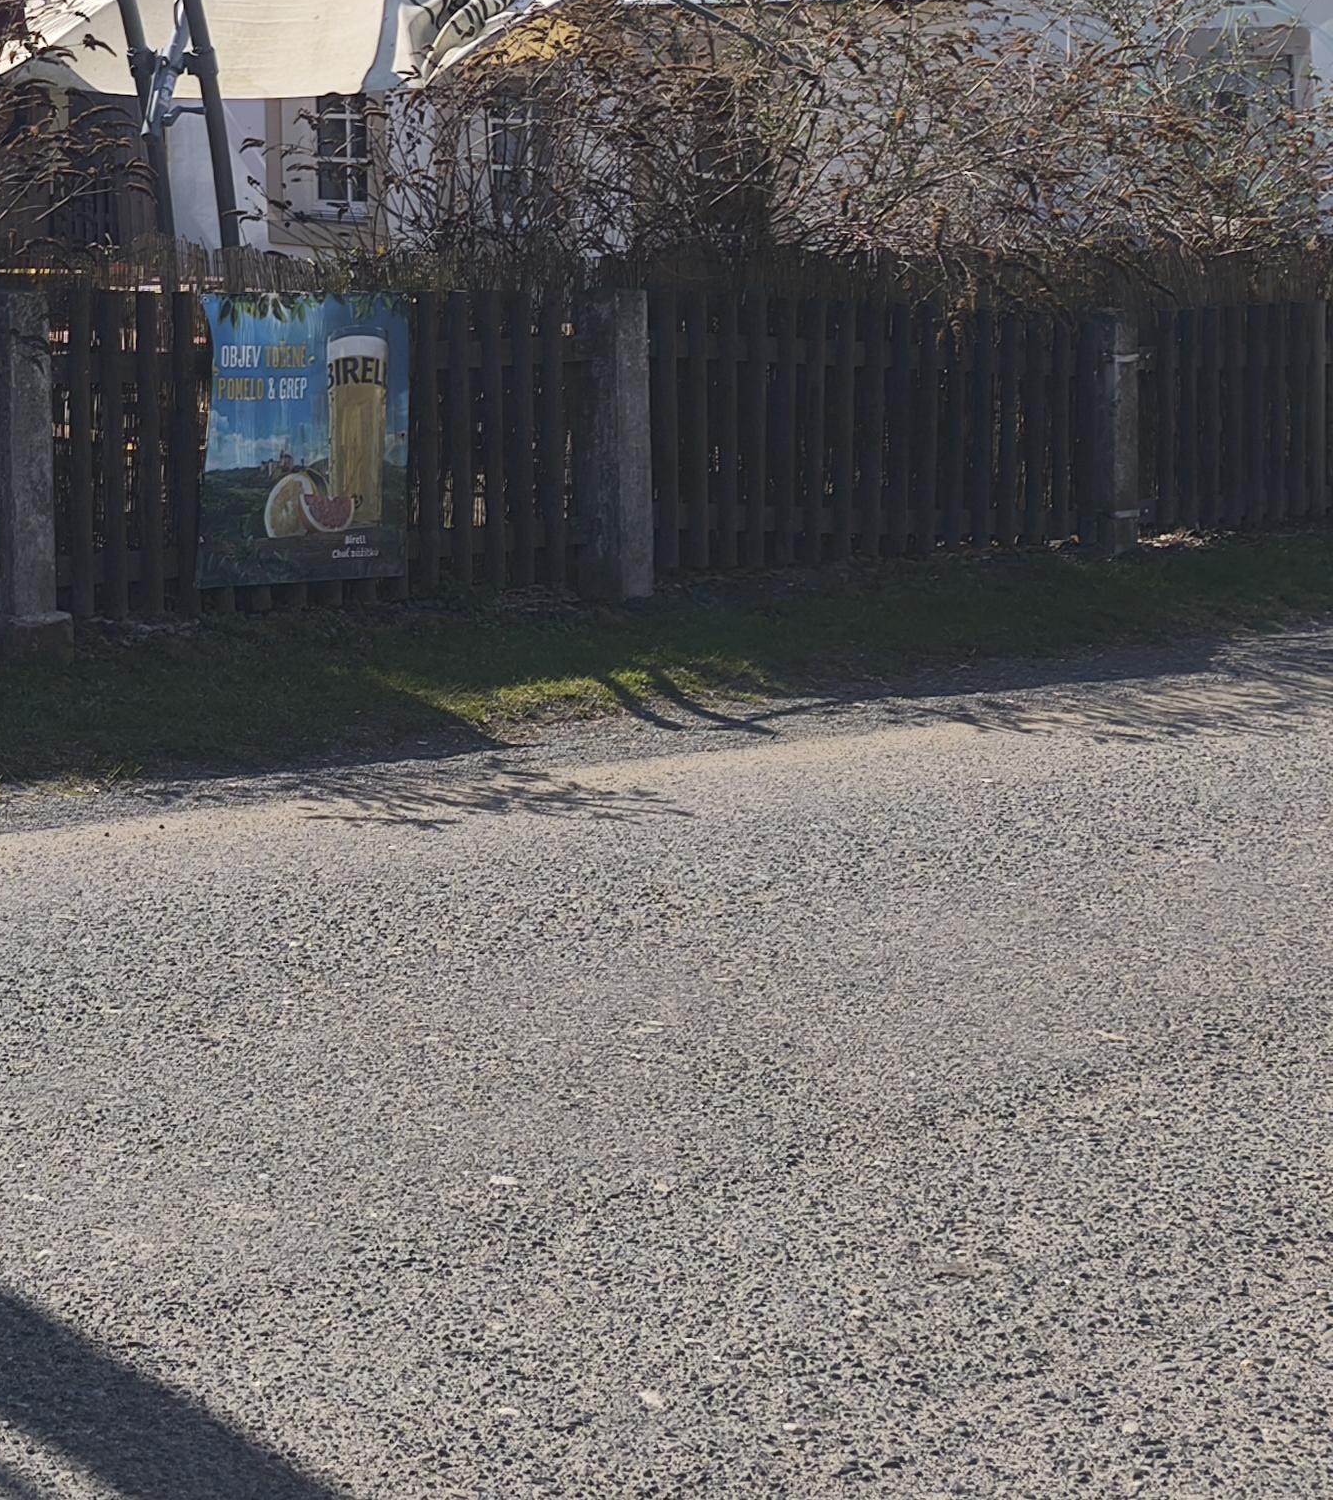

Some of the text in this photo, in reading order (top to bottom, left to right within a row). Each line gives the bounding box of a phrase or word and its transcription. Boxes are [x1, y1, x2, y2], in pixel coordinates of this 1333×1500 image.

[221, 344, 262, 369] OBJEV
[217, 377, 309, 402] POMELO & GREP
